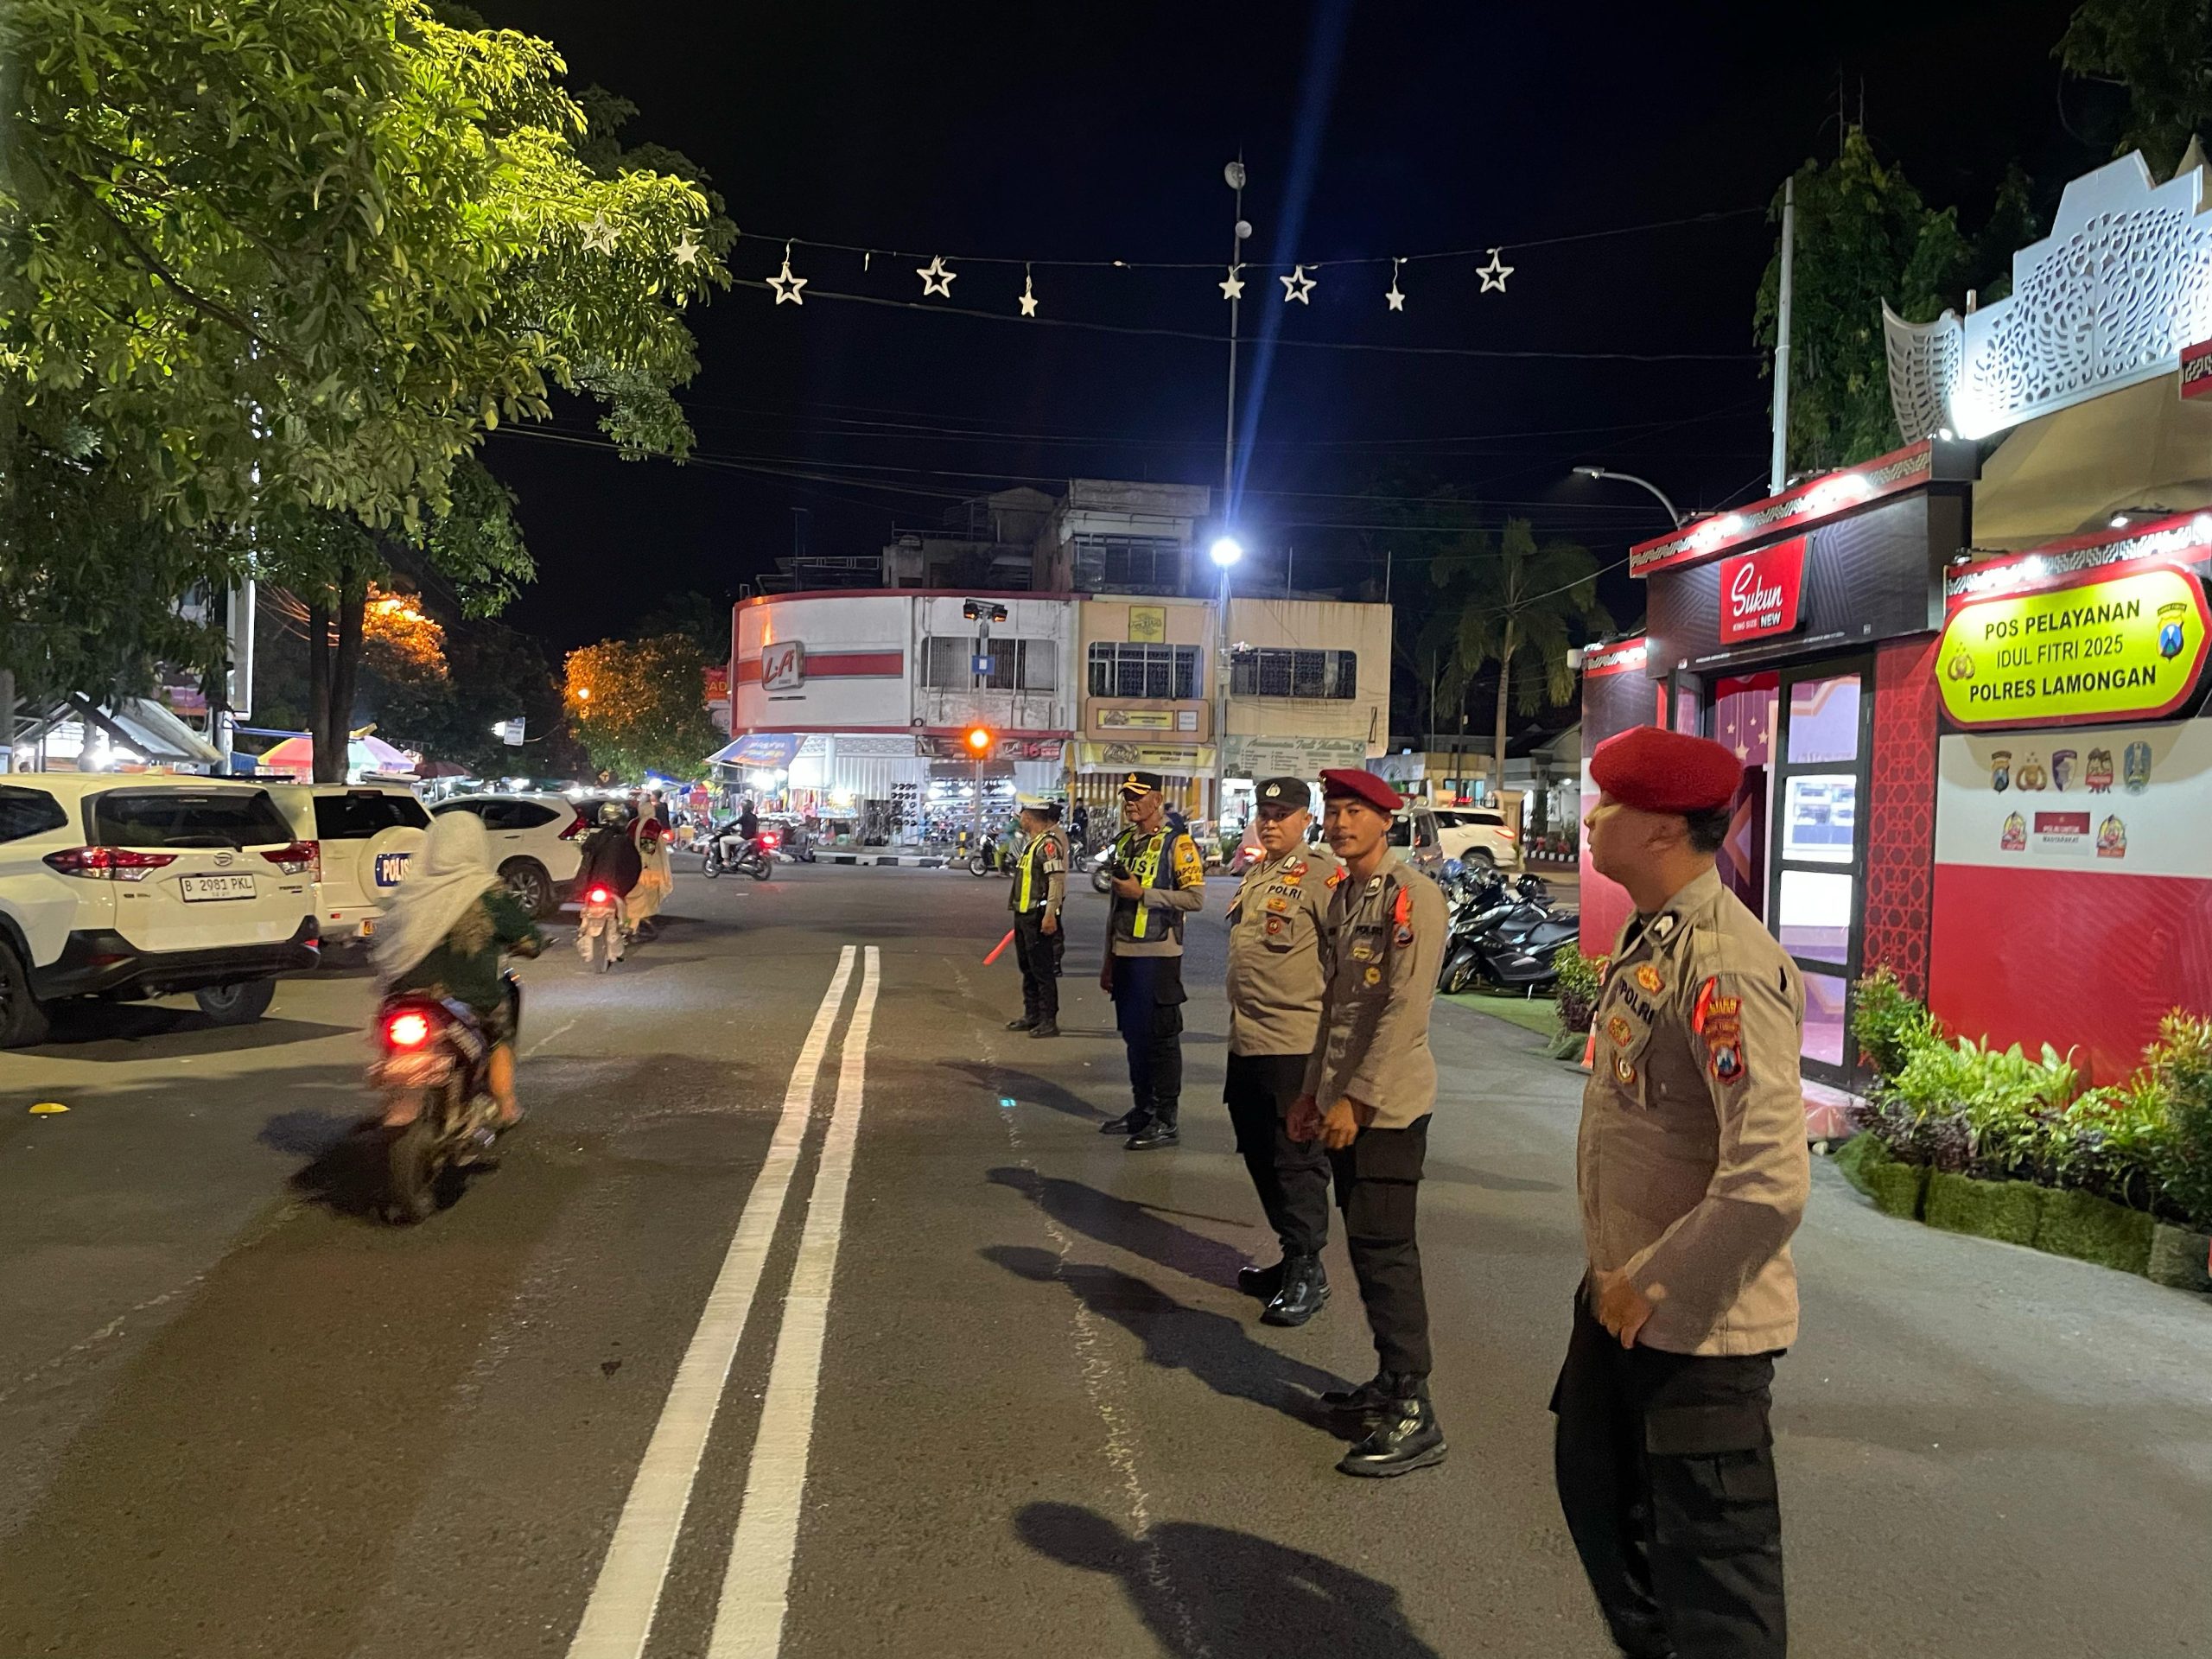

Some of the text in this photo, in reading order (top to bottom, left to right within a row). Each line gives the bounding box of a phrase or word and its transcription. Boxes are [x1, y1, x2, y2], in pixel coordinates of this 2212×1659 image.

[1732, 562, 1783, 616] Sukun
[1760, 611, 1782, 628] NEW
[1985, 619, 2019, 641] POS
[2025, 599, 2140, 635] PELAYANAN
[1997, 634, 2124, 670] IDUL FITRI 2025
[704, 681, 728, 691] AD
[1969, 665, 2157, 702] POLRES LAMONGAN
[184, 877, 252, 892] B 2981 PKL
[1268, 884, 1302, 899] POLRI
[1619, 976, 1656, 1026] POLRI
